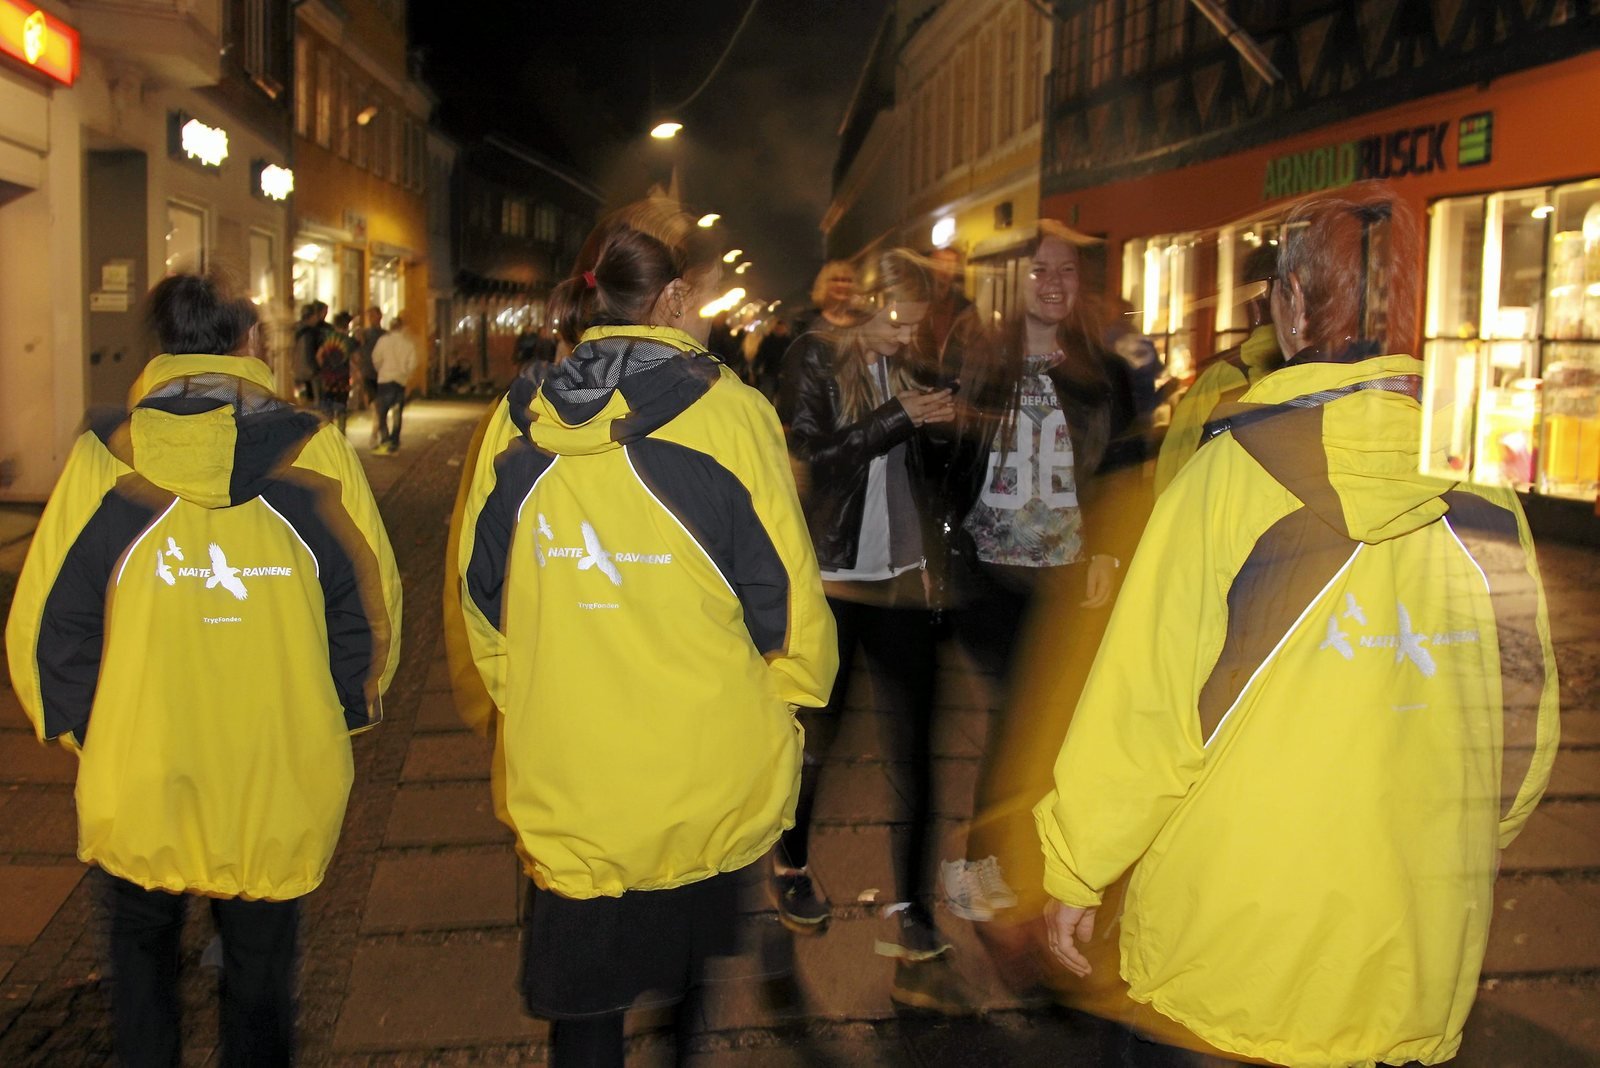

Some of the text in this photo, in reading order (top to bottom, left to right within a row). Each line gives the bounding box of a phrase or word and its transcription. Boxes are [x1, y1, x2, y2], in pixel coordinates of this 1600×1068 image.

[547, 548, 583, 558] NATTE
[242, 566, 292, 577] RAVNENE
[577, 602, 620, 610] TrygFonden
[203, 616, 242, 624] TrygFonden
